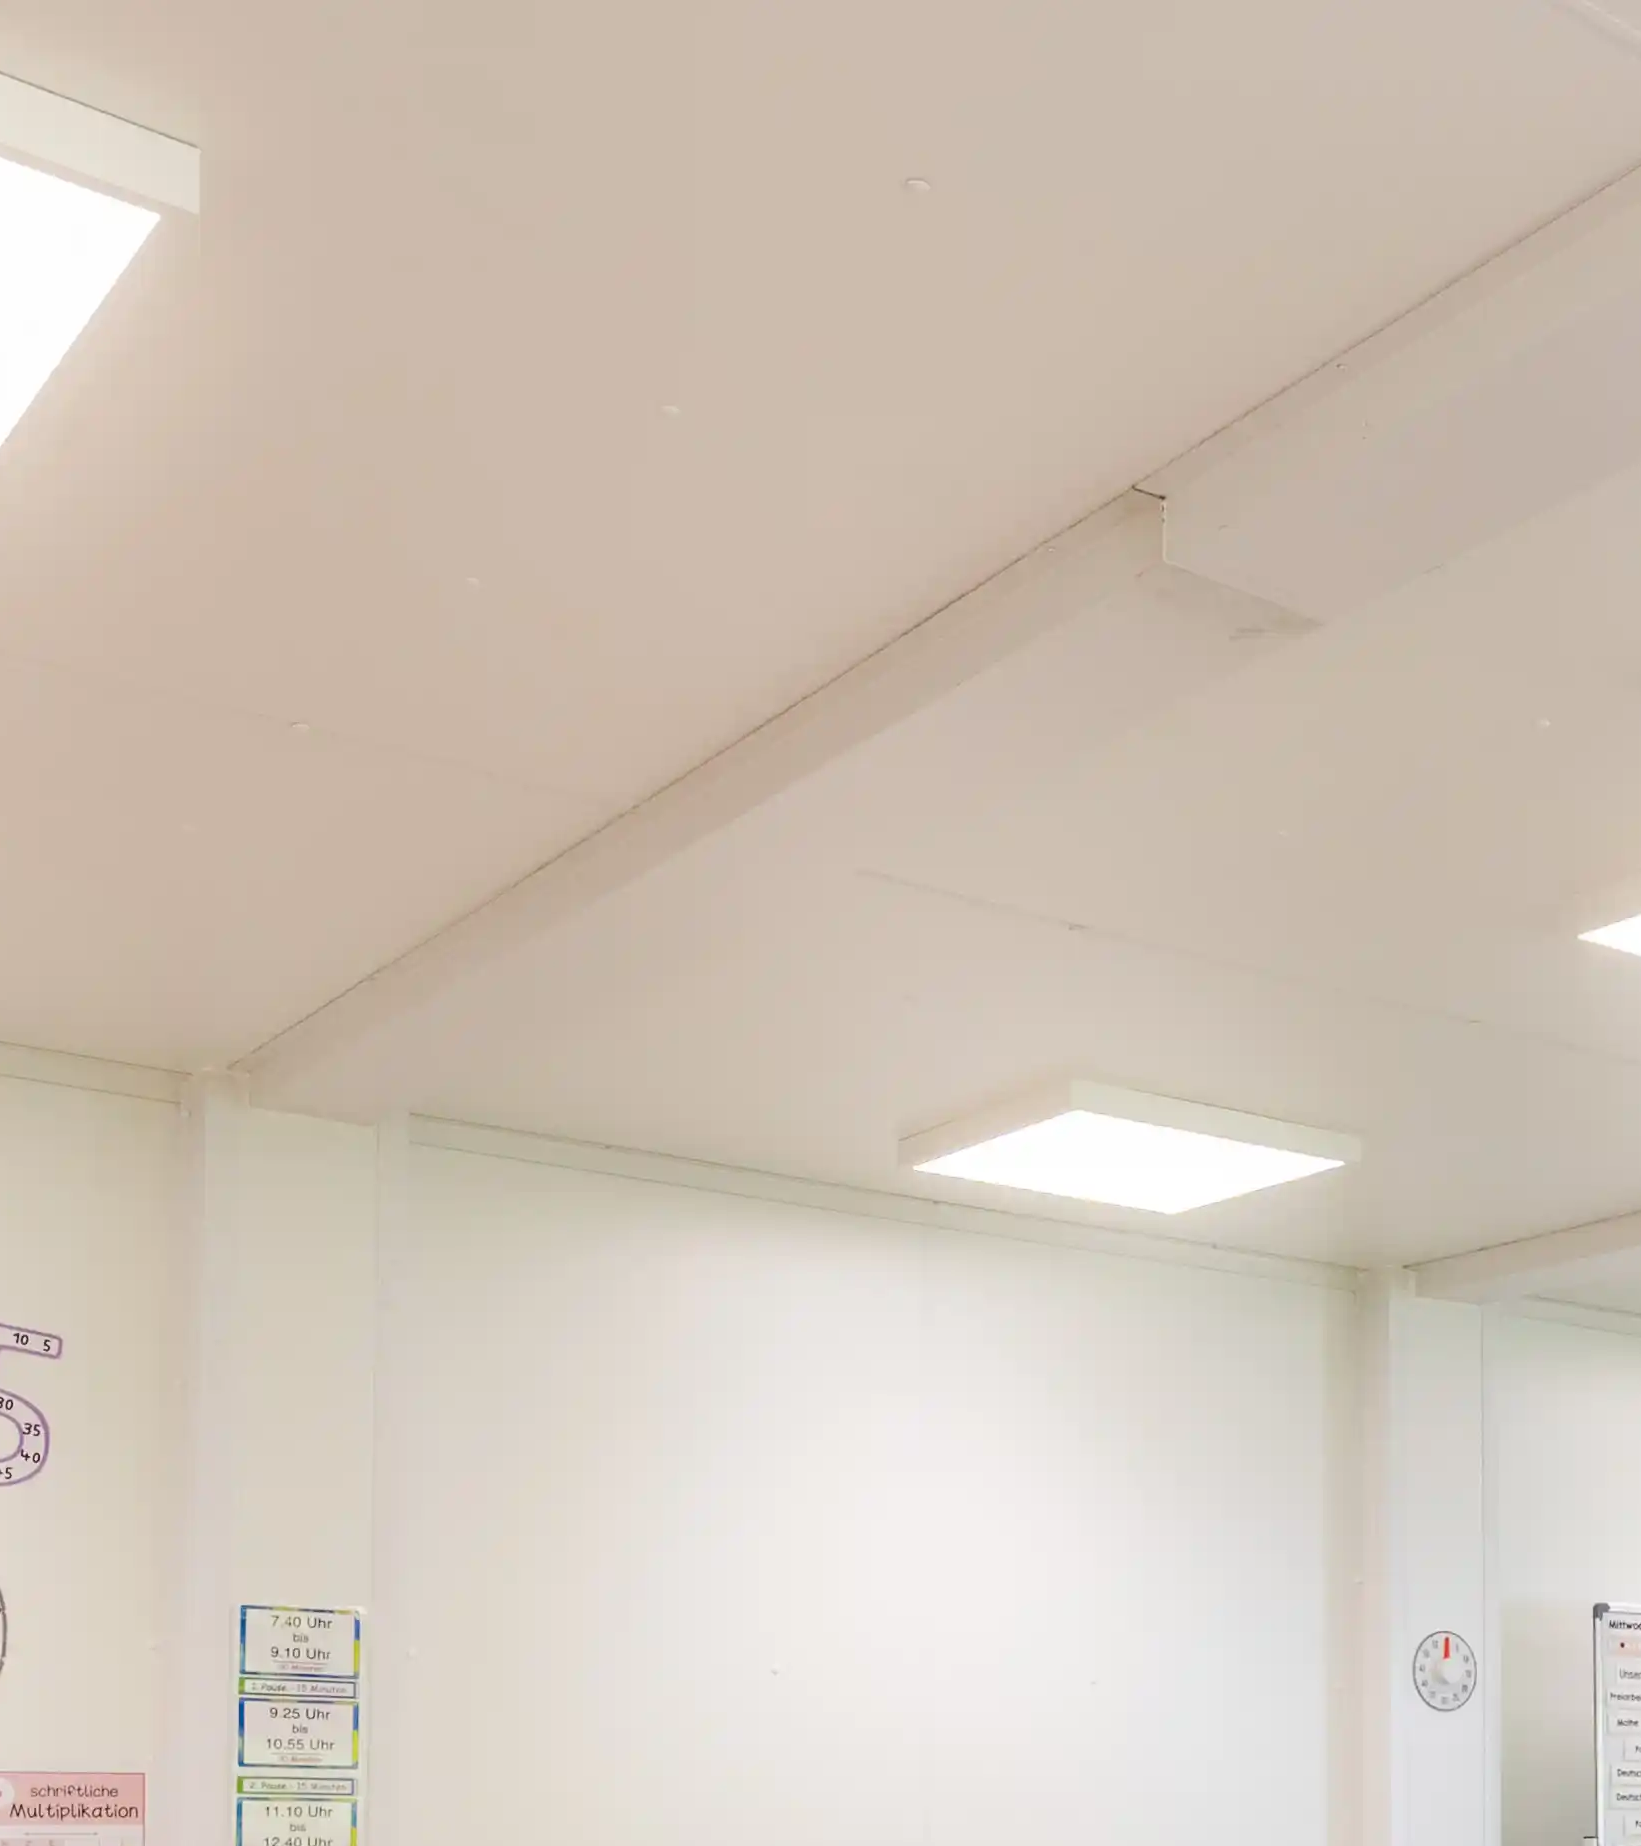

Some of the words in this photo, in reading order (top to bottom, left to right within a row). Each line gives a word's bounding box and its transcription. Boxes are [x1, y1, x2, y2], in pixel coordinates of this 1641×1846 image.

[307, 1618, 332, 1629] Uhr
[293, 1634, 309, 1642] bis
[271, 1646, 300, 1659] 9.10
[306, 1648, 331, 1660] Uhr
[306, 1708, 330, 1720] Uhr
[292, 1725, 308, 1733] bis
[267, 1739, 304, 1750] 10.55
[310, 1739, 335, 1750] Uhr
[30, 1785, 118, 1798] schriftliche
[9, 1804, 139, 1821] Multiplikation
[265, 1806, 302, 1817] 11.10
[309, 1805, 333, 1817] Uhr
